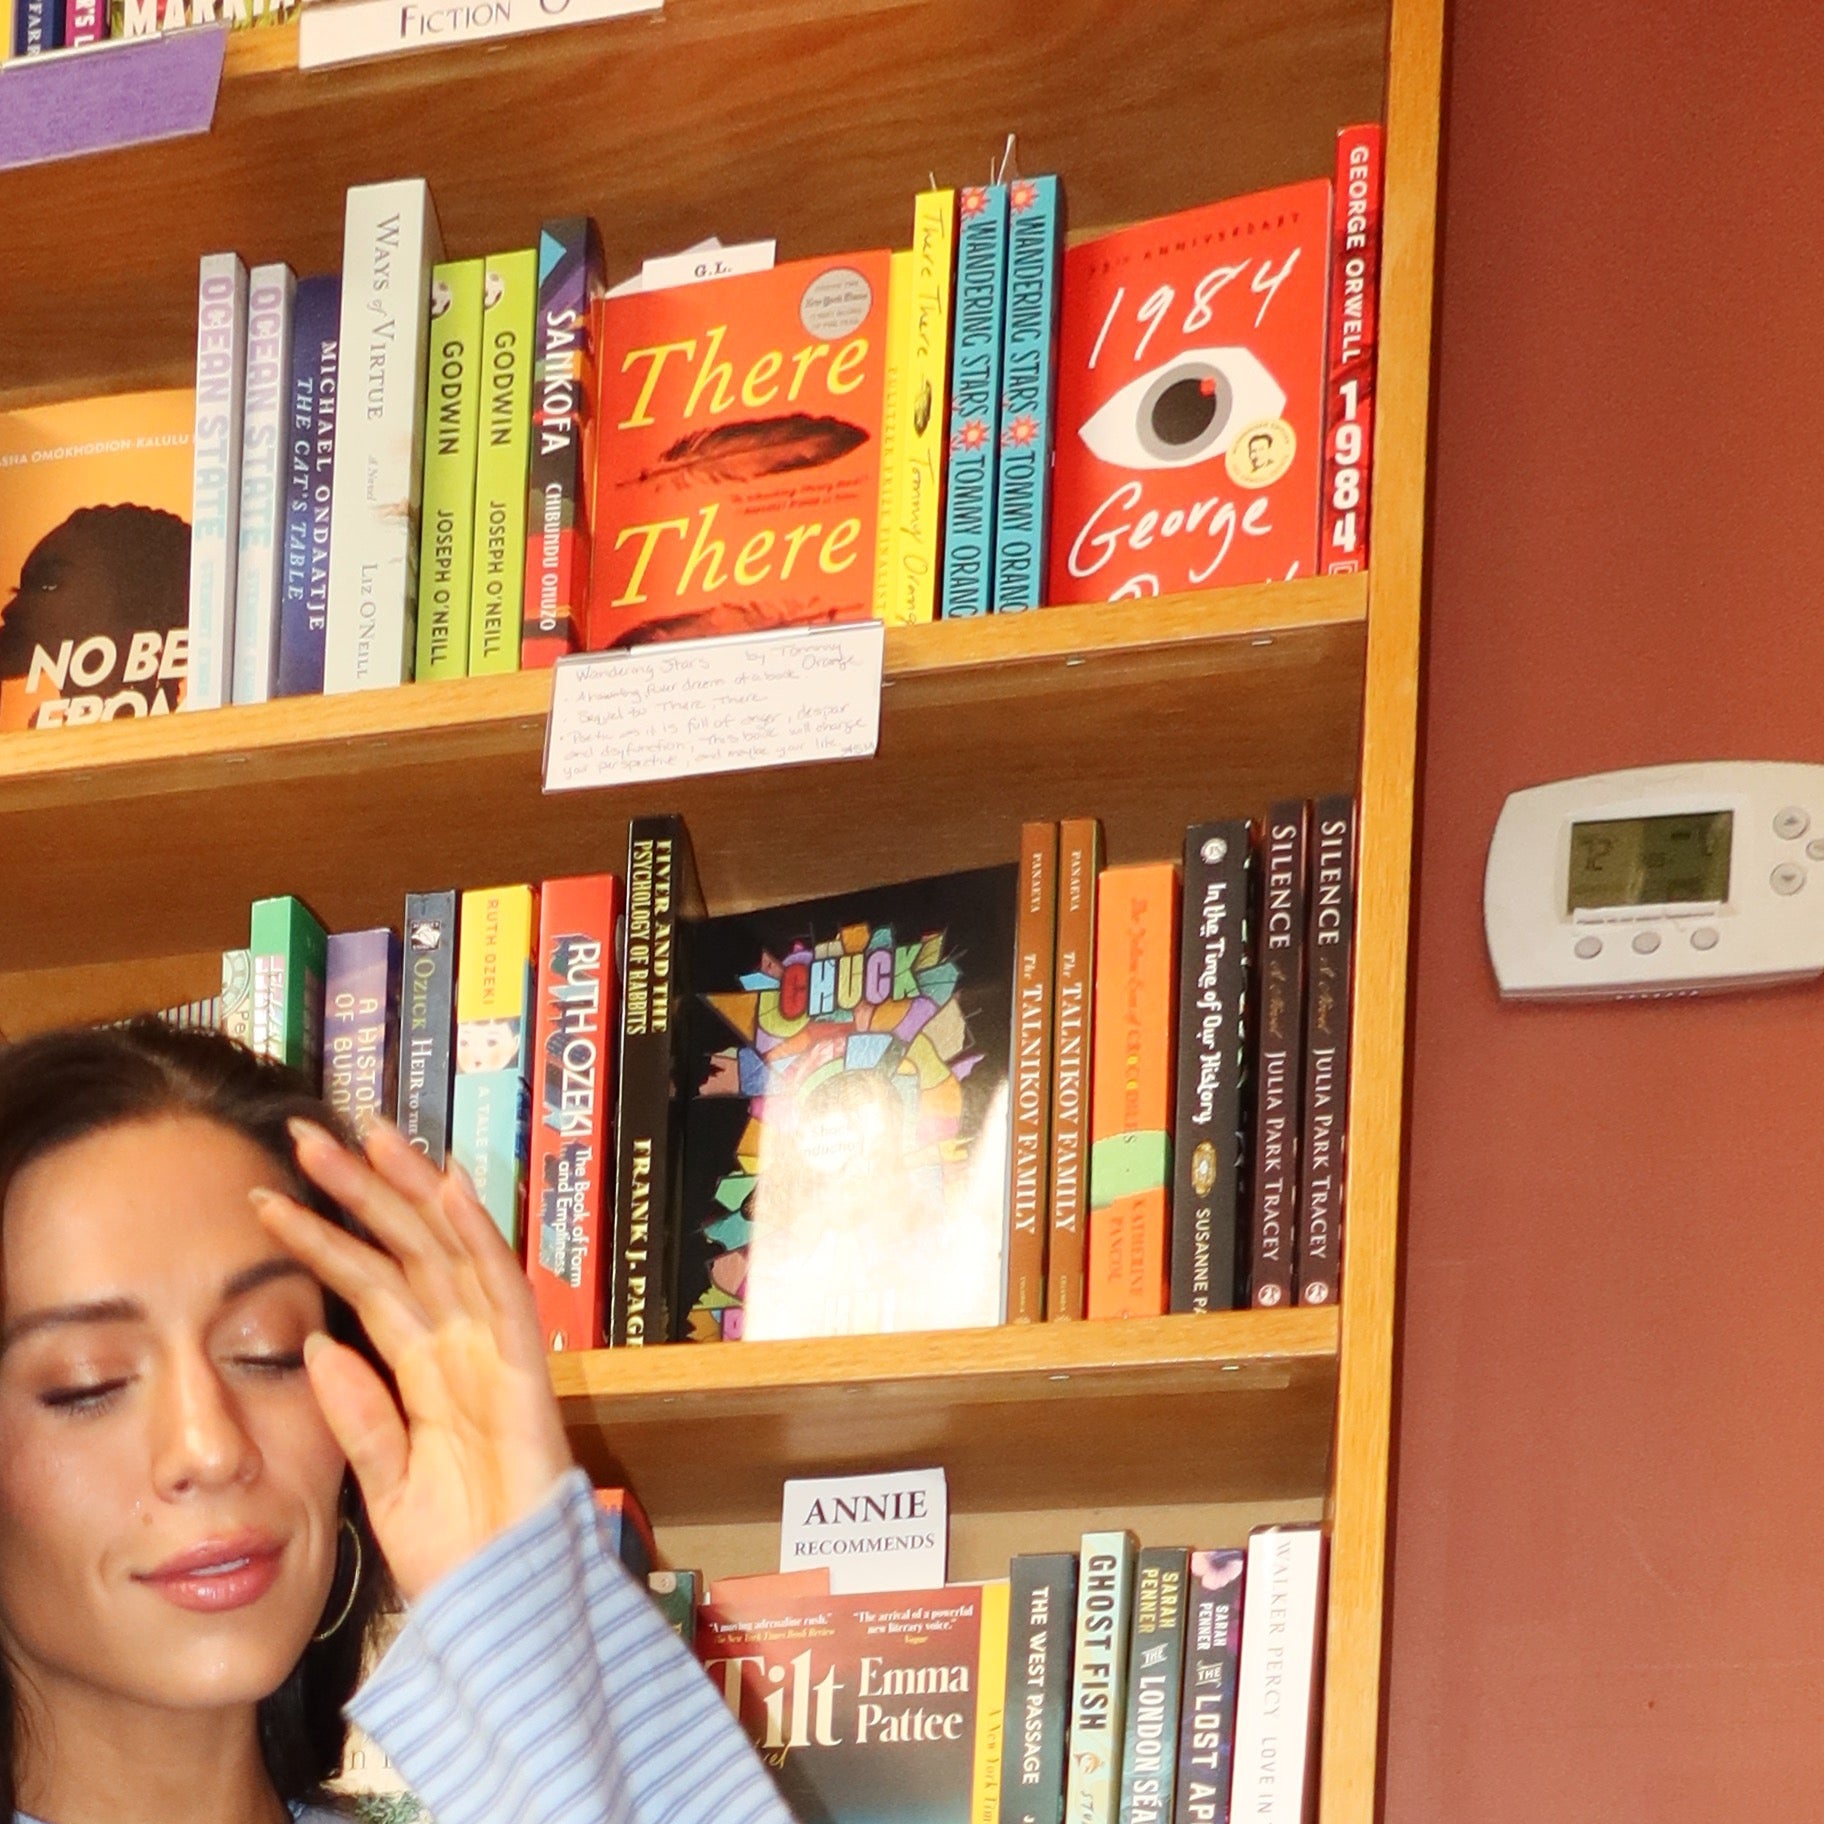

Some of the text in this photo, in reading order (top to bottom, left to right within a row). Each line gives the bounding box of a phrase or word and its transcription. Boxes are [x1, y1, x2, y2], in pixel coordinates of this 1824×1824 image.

[693, 261, 732, 277] G.L.
[1008, 215, 1046, 416] WANDERING STARS
[1088, 248, 1301, 369] 1984
[438, 341, 464, 455] GODWIN
[540, 311, 576, 455] SANKOFA
[618, 324, 870, 431] There
[1332, 146, 1369, 554] GEORGE ORWELL 1984
[309, 341, 338, 630] MICHAEL ONDAATJE
[1067, 482, 1273, 585] George
[610, 504, 861, 609] There
[27, 636, 117, 694] NO
[576, 661, 654, 684] Wandering
[661, 657, 710, 674] Stars
[745, 650, 766, 664] by
[779, 944, 919, 1019] CHUCK
[560, 941, 601, 1137] RUTH OZEKI
[1305, 820, 1346, 1261] SILENCE JULIA PARK TRACEY
[793, 1532, 935, 1558] RECOMMENDS
[804, 1489, 928, 1528] ANNIE
[868, 1624, 886, 1635] new
[888, 1622, 922, 1635] literary
[878, 1608, 910, 1622] arrival
[912, 1608, 922, 1620] of
[931, 1604, 974, 1620] powerful
[1079, 1555, 1116, 1731] GHOST FISH
[856, 1705, 963, 1744] Pattee
[858, 1656, 969, 1699] Emma
[1022, 1586, 1050, 1785] THE WEST PASSAGE
